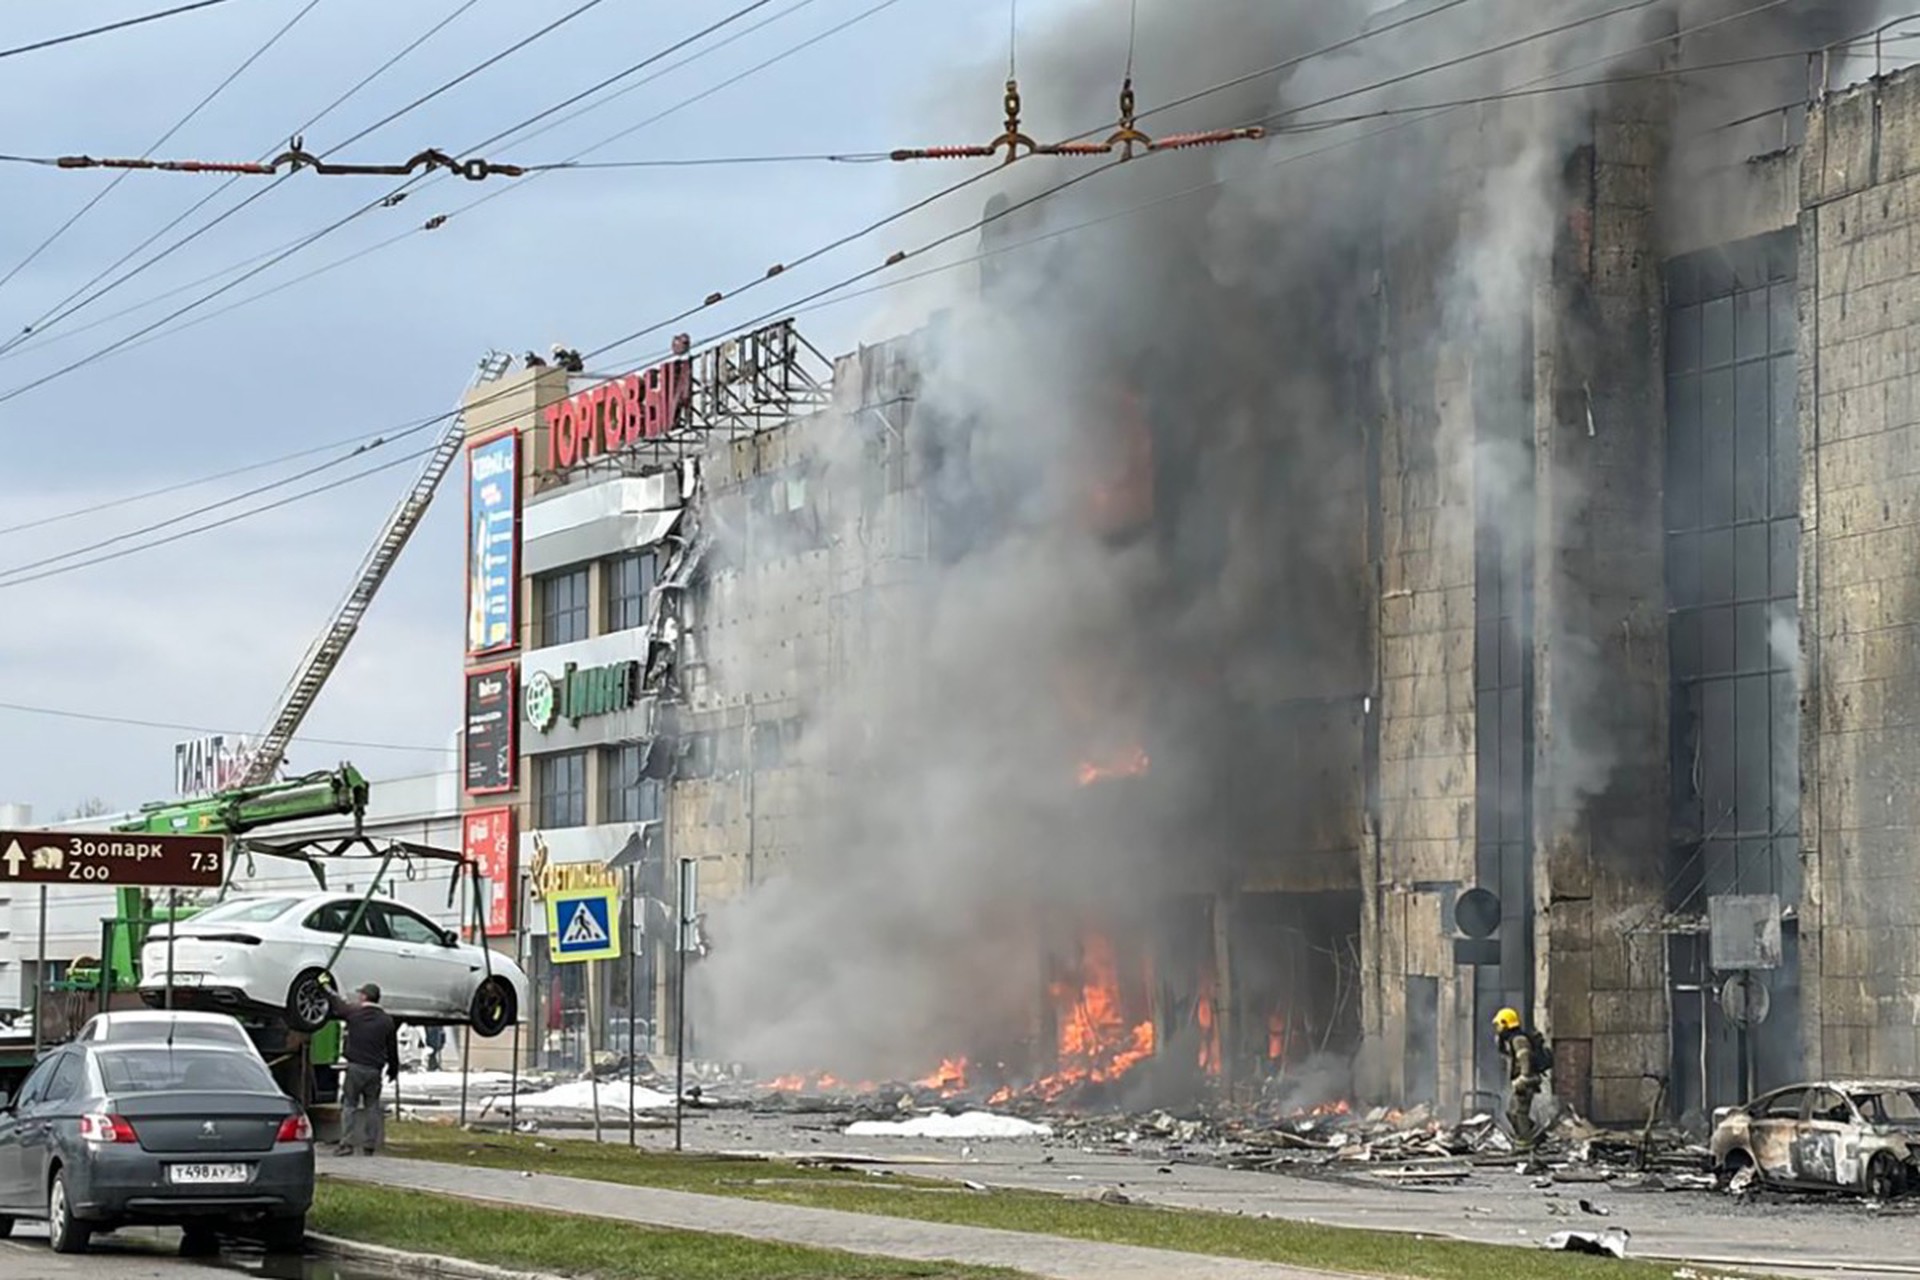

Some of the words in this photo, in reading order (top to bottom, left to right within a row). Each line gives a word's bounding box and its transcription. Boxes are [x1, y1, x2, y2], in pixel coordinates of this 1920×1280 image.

[544, 334, 691, 471] ТОРГОВЫЙ
[69, 838, 163, 862] Зоопарк
[68, 862, 110, 880] Zoo
[190, 853, 219, 873] 7,3
